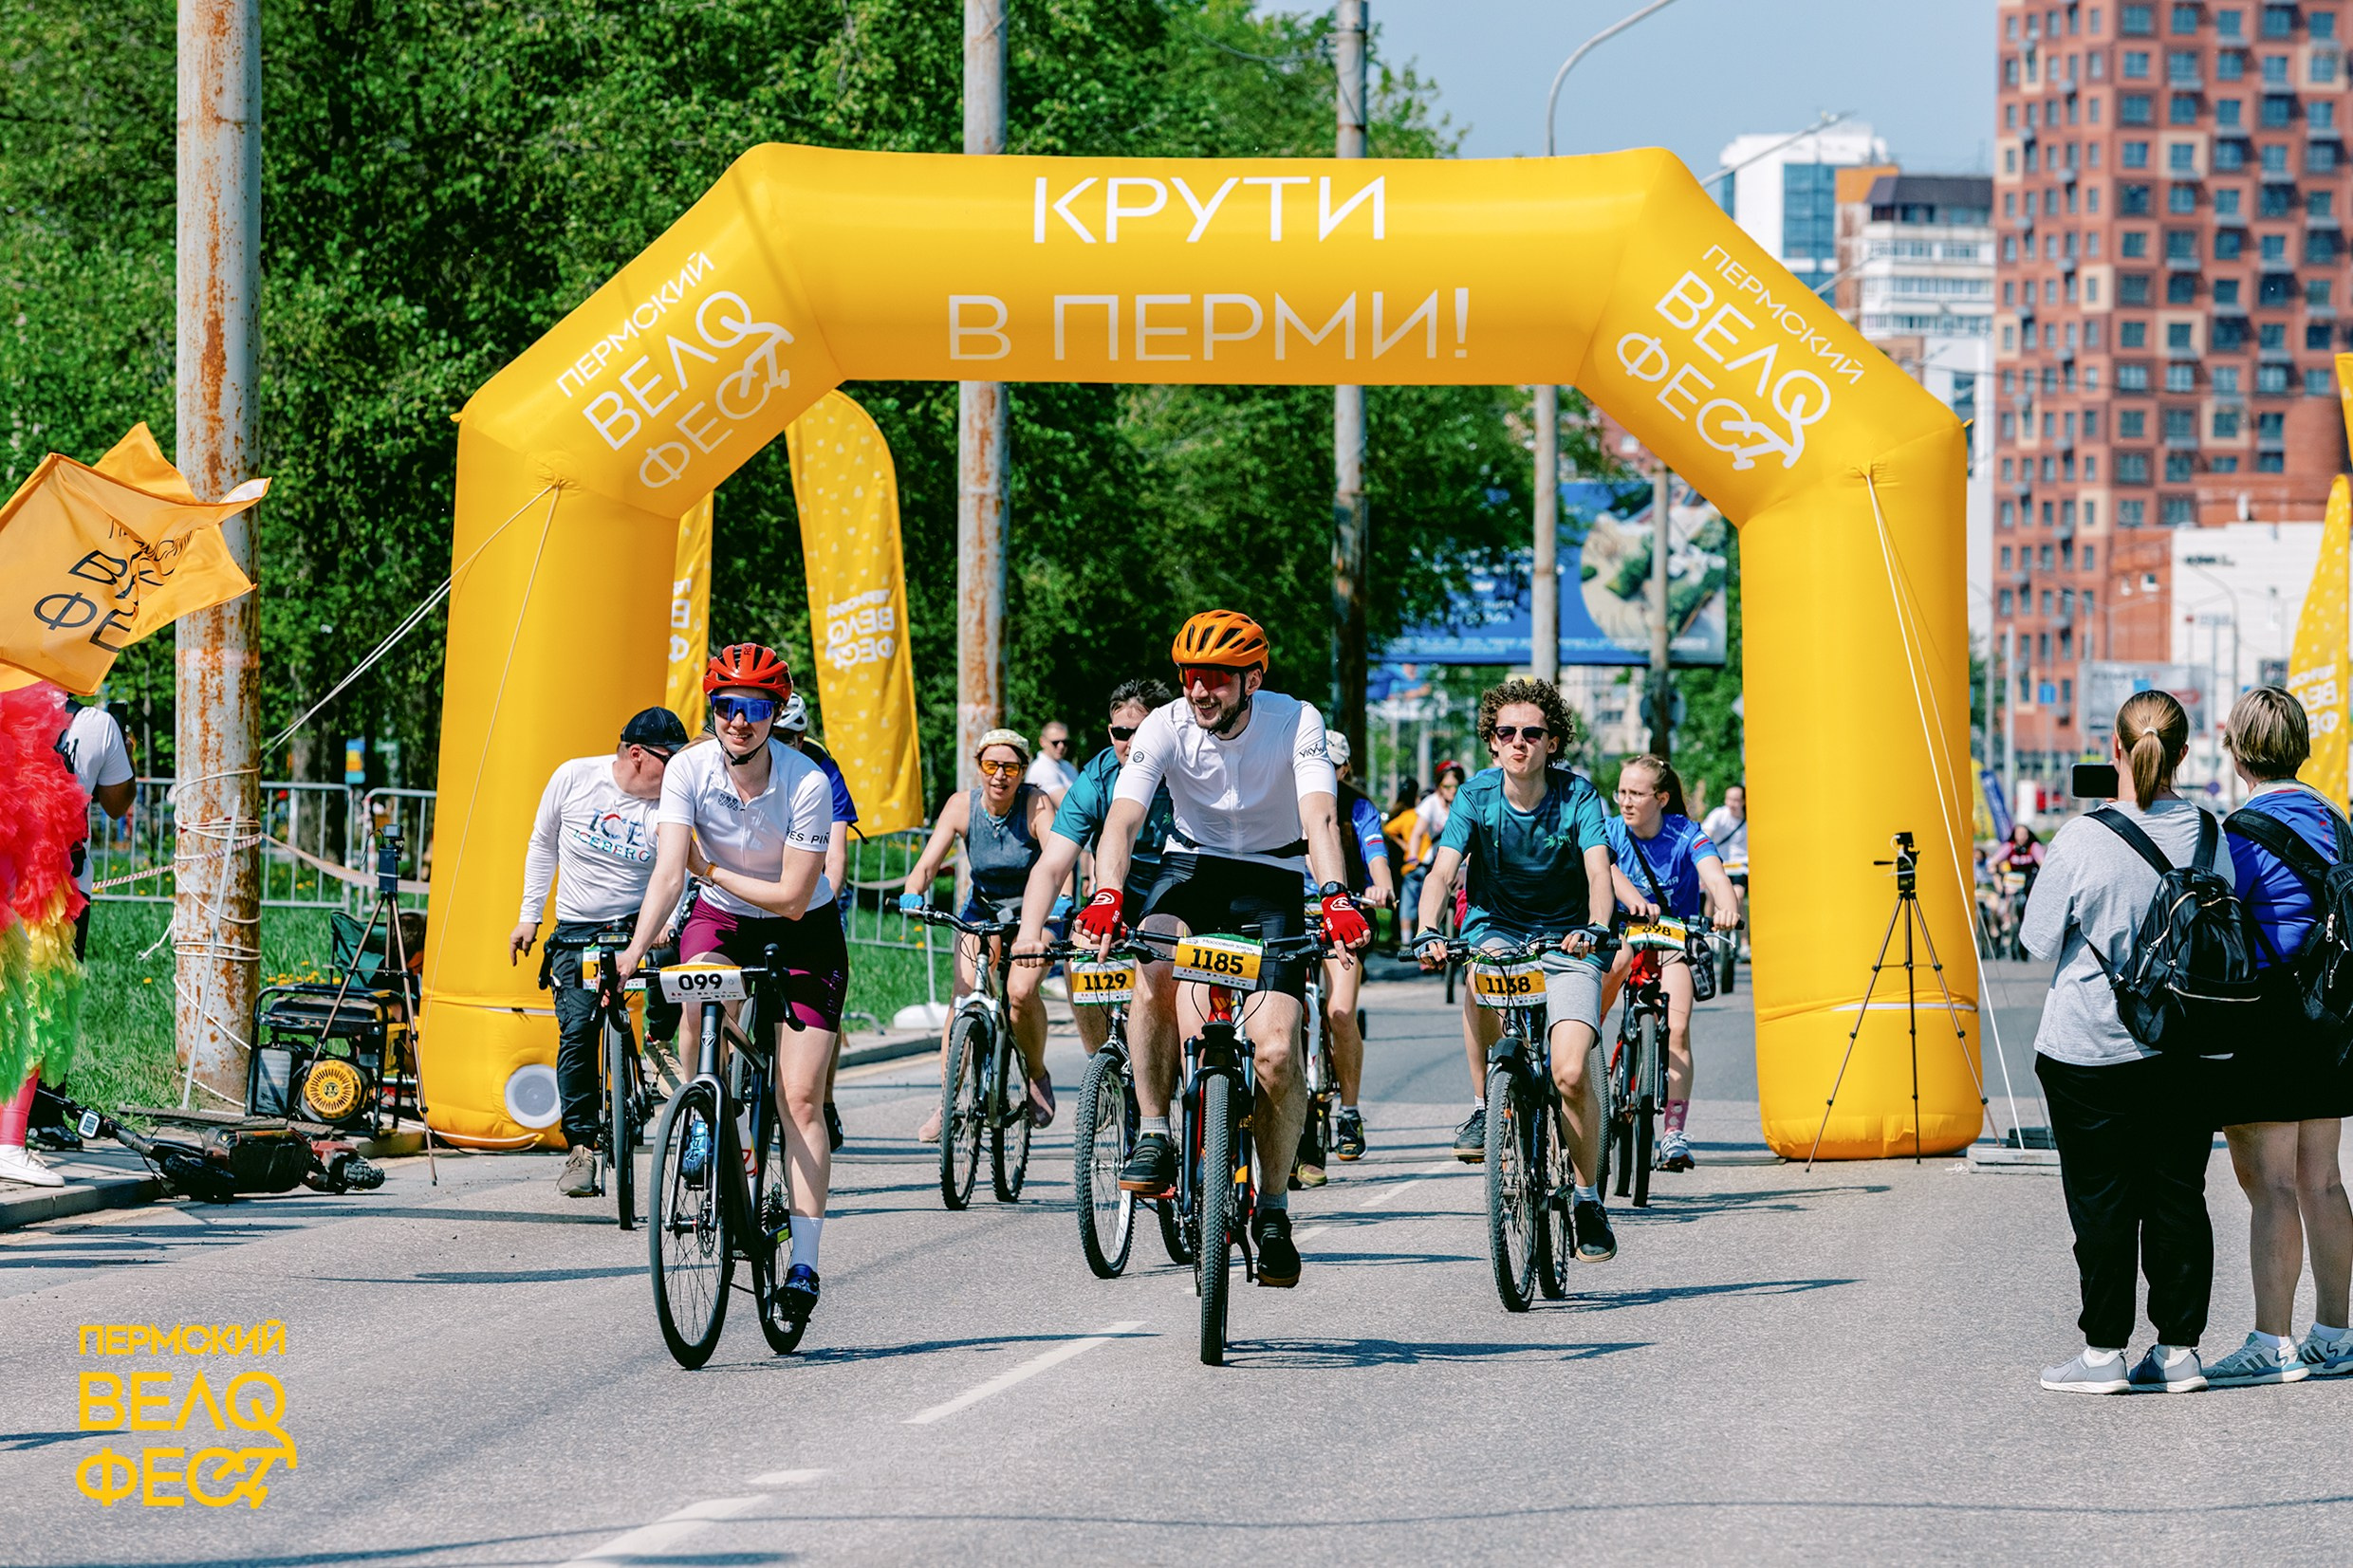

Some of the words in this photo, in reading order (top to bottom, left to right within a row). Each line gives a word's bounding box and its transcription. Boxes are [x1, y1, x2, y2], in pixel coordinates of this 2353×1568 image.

[1033, 175, 1386, 244] КРУТИ
[556, 250, 715, 398] ПЕРМСКИЙ
[949, 294, 1012, 360] В
[1053, 287, 1470, 361] ПЕРМИ!
[1701, 244, 1865, 385] ПЕРМСКИЙ
[572, 828, 652, 863] ICEBERG
[588, 807, 646, 847] ICE
[678, 973, 723, 990] 099
[1084, 972, 1127, 990] 1129
[1190, 948, 1244, 975] 1185
